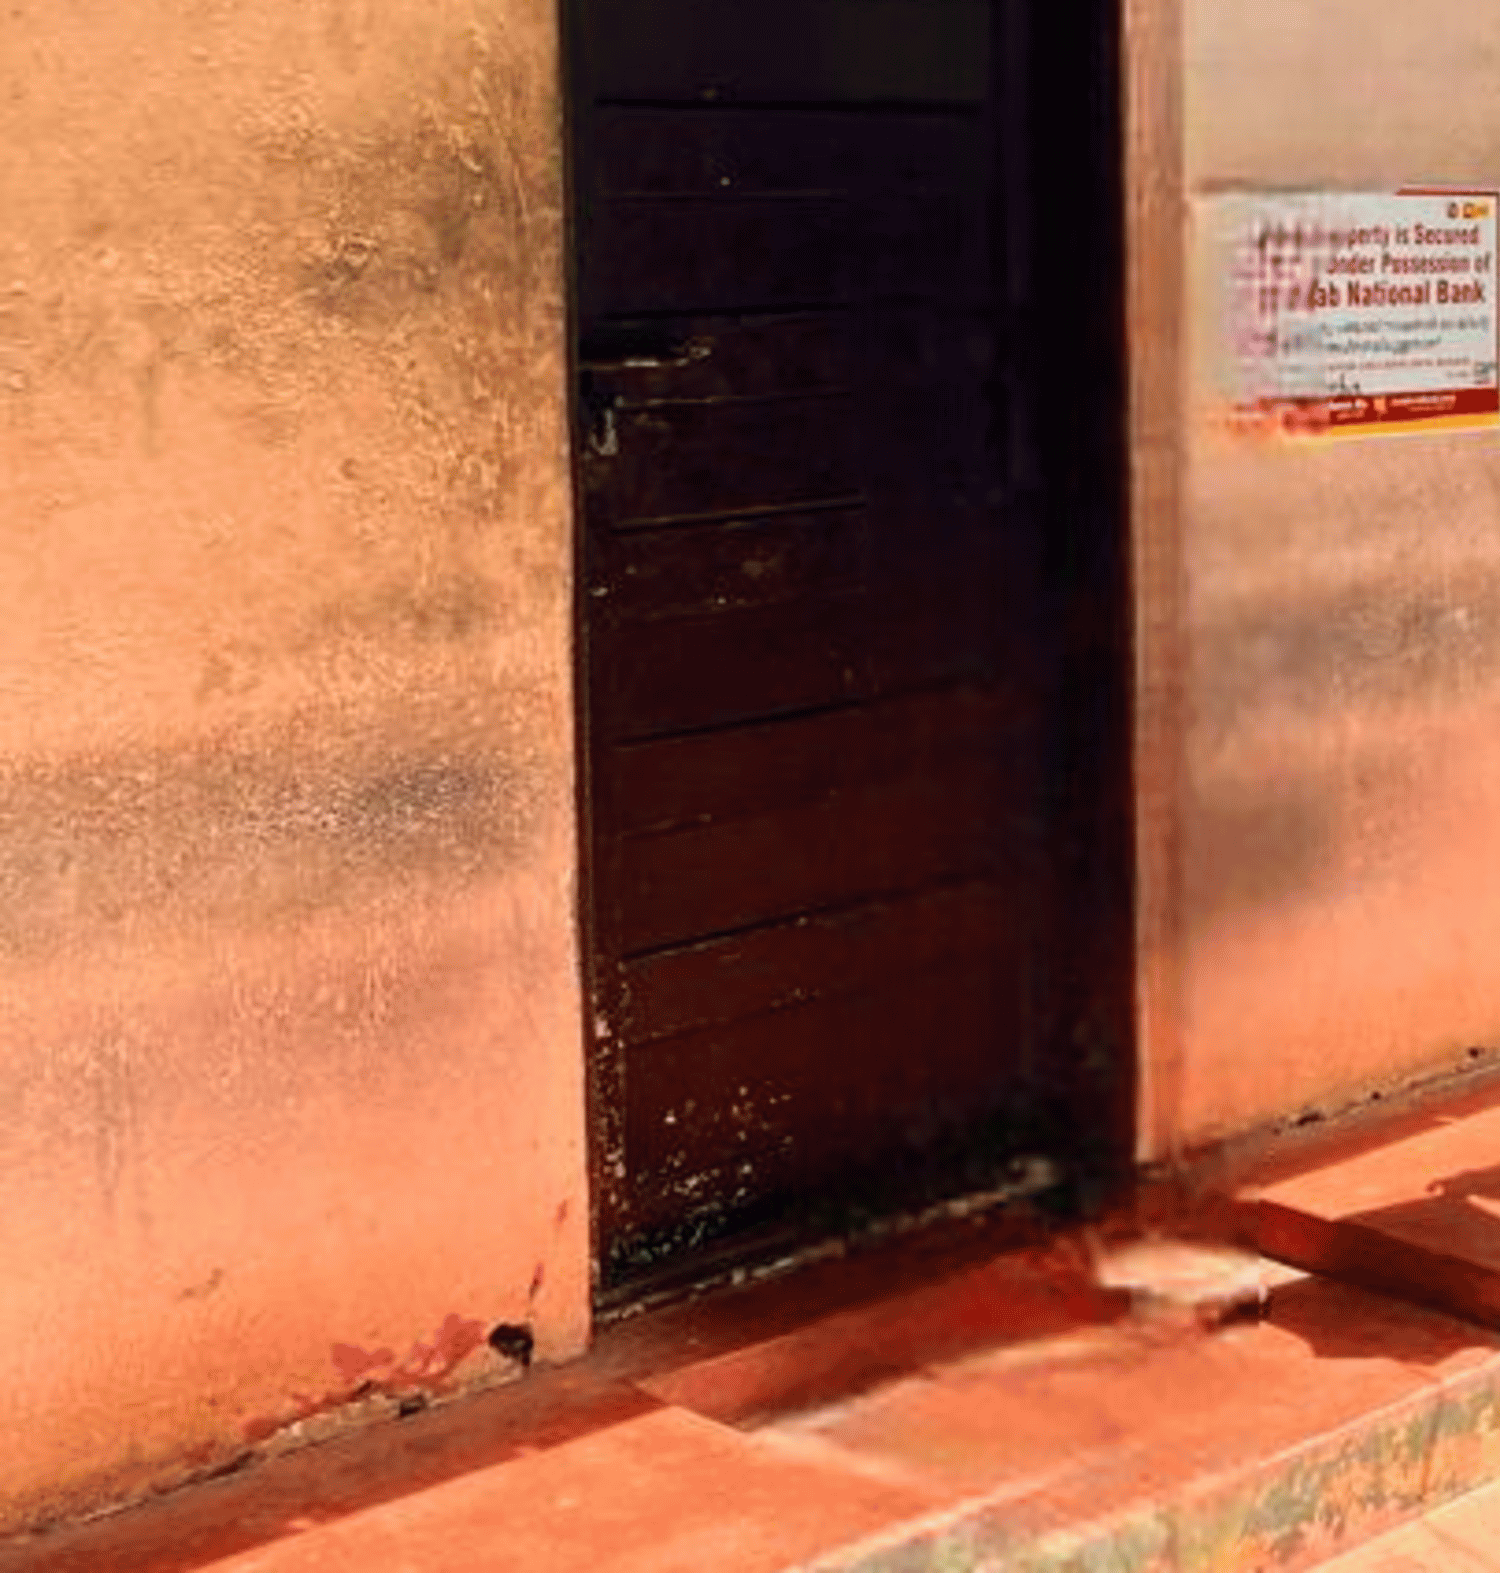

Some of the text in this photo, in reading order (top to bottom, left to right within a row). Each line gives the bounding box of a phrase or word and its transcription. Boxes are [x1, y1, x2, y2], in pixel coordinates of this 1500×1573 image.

[1331, 222, 1480, 250] perty is Secured
[1380, 250, 1470, 275] Possession
[1474, 250, 1491, 274] of
[1346, 279, 1430, 307] National
[1436, 278, 1487, 305] Bank
